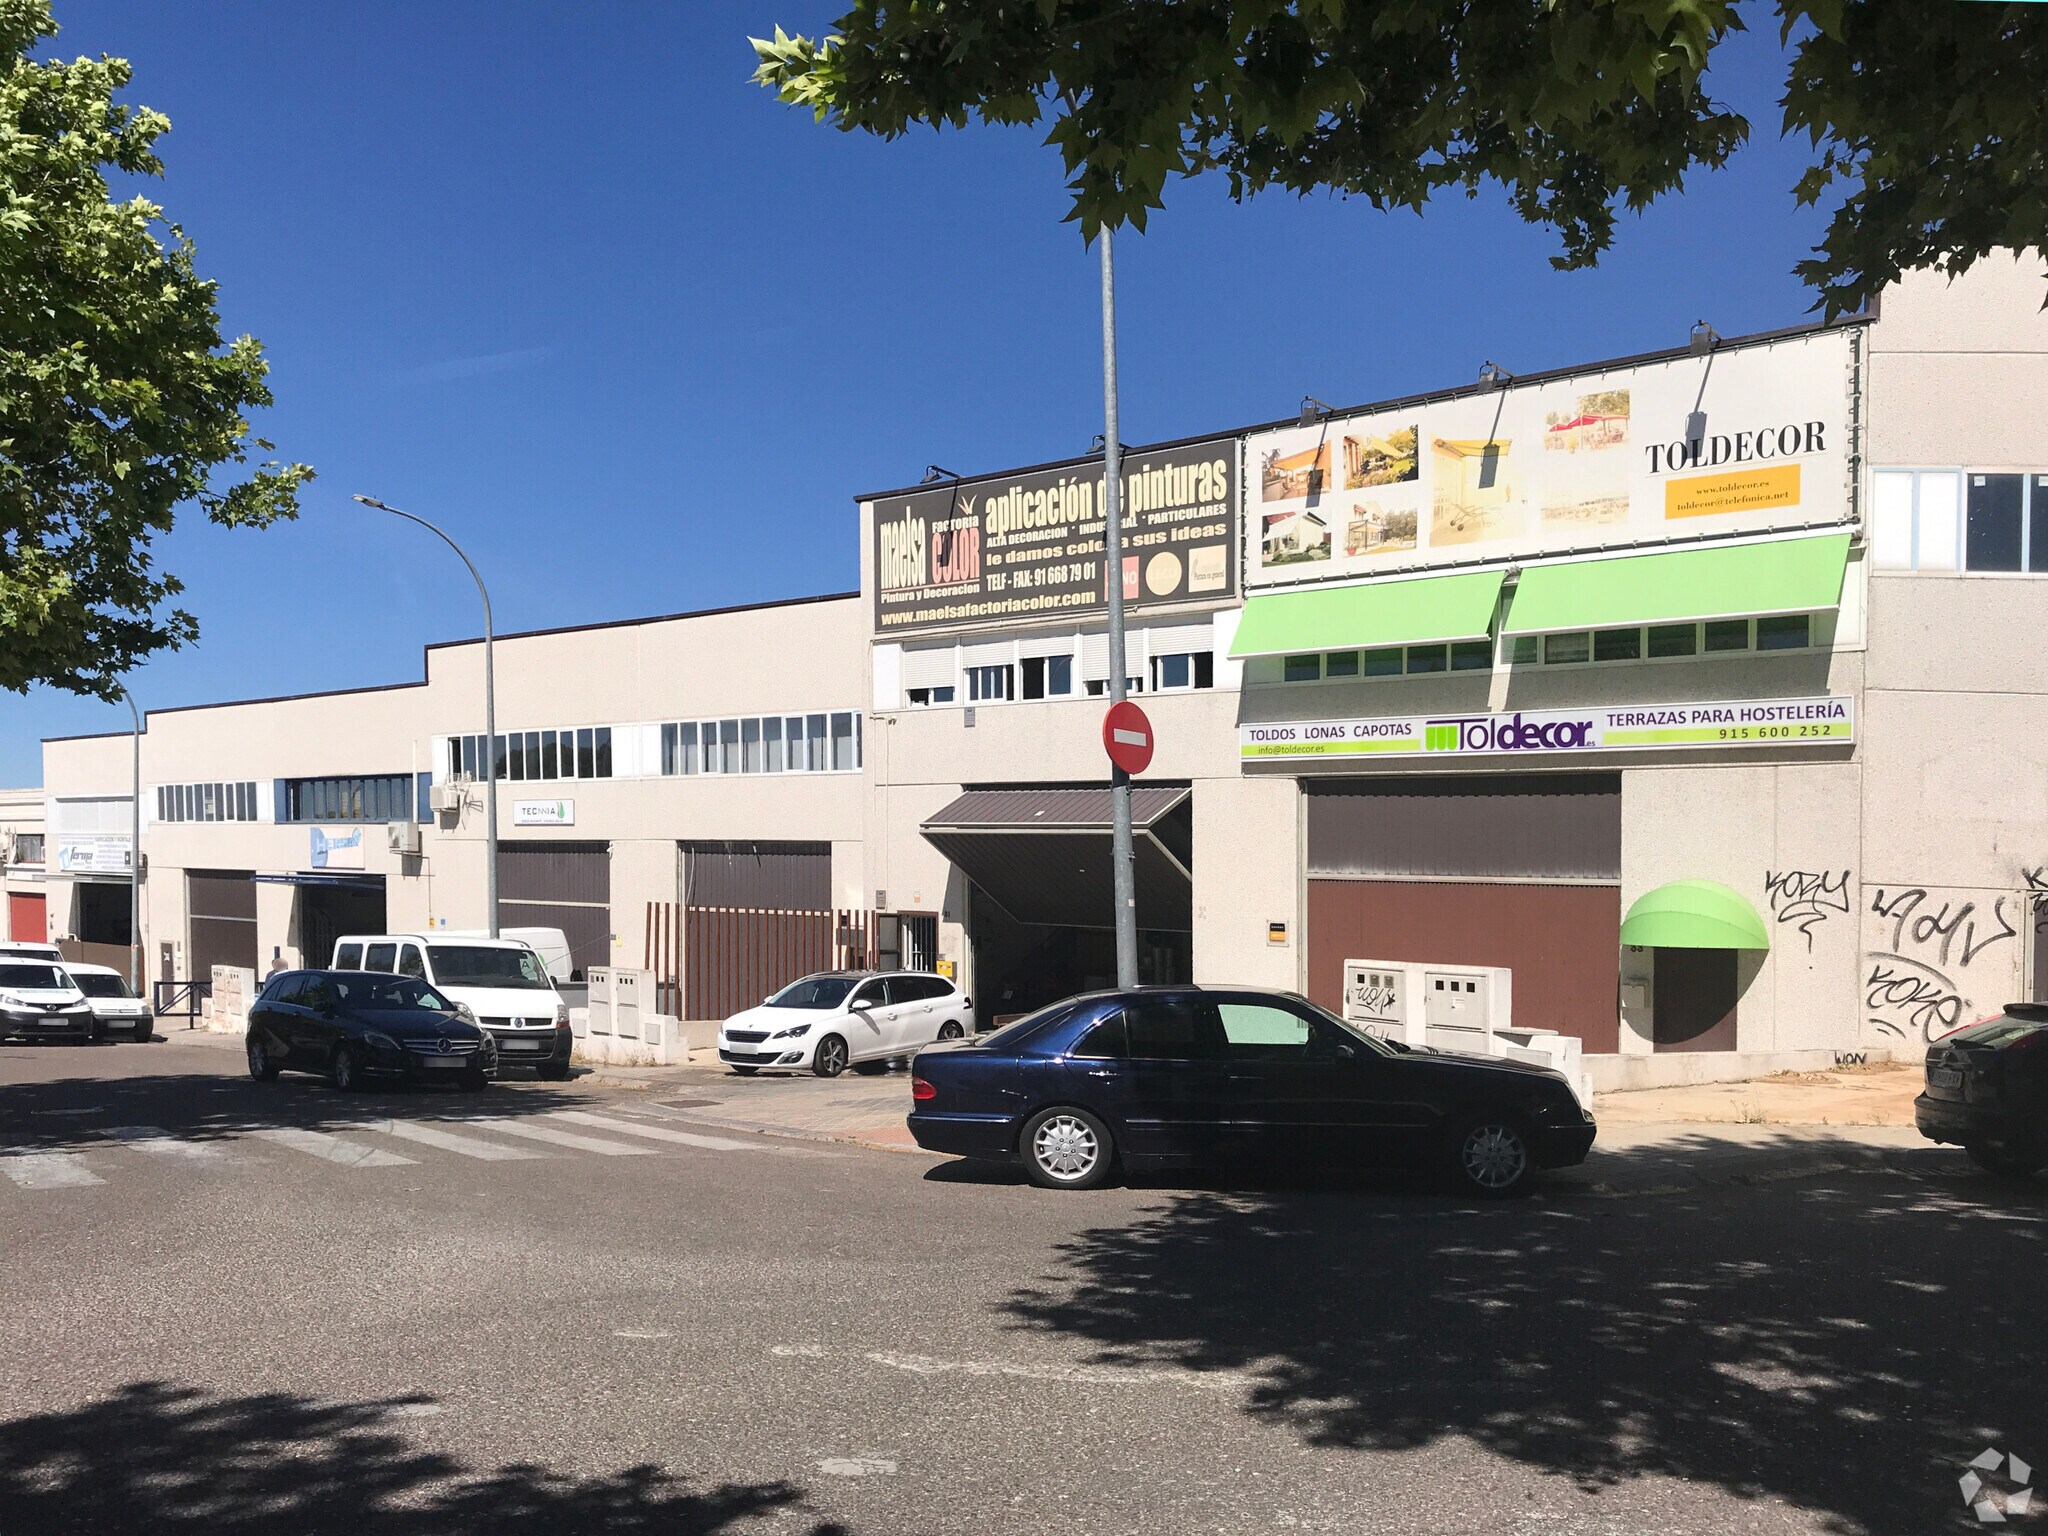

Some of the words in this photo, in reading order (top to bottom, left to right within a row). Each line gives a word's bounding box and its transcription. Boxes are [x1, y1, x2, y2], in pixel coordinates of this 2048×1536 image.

[1645, 420, 1826, 473] TOLDECOR
[985, 477, 1092, 539] aplicación
[1129, 459, 1227, 518] pinturas
[1677, 491, 1789, 511] toldecor@telefonica.net
[1696, 480, 1770, 495] www.toldecor.es
[986, 534, 1007, 548] ALTA
[1008, 526, 1068, 545] DECORACION
[1147, 503, 1227, 526] PARTICULARES
[880, 505, 927, 590] maelsa
[932, 527, 980, 584] COLOR
[986, 553, 1003, 566] le
[1005, 545, 1063, 564] damos
[1133, 531, 1167, 547] sus
[1171, 523, 1227, 542] ideas
[986, 572, 1007, 591] TELF
[1013, 569, 1033, 589] FAX:
[1034, 567, 1046, 586] 91
[1047, 564, 1068, 584] 668
[1069, 563, 1081, 582] 79
[1083, 561, 1096, 581] 01
[881, 591, 915, 604] Pintura
[916, 591, 922, 601] y
[881, 591, 1096, 626] www.maelsafactoriacolor.com
[1607, 710, 1687, 727] TERRAZAS
[1692, 708, 1736, 724] PARA
[1740, 700, 1846, 721] HOSTELERÍA
[1249, 728, 1296, 741] TOLDOS
[1304, 726, 1346, 739] LONAS
[1353, 723, 1412, 738] CAPOTAS
[1719, 728, 1749, 739] 915
[1759, 726, 1789, 738] 600
[1800, 725, 1831, 737] 252
[1258, 744, 1325, 756] info@toldecor.es
